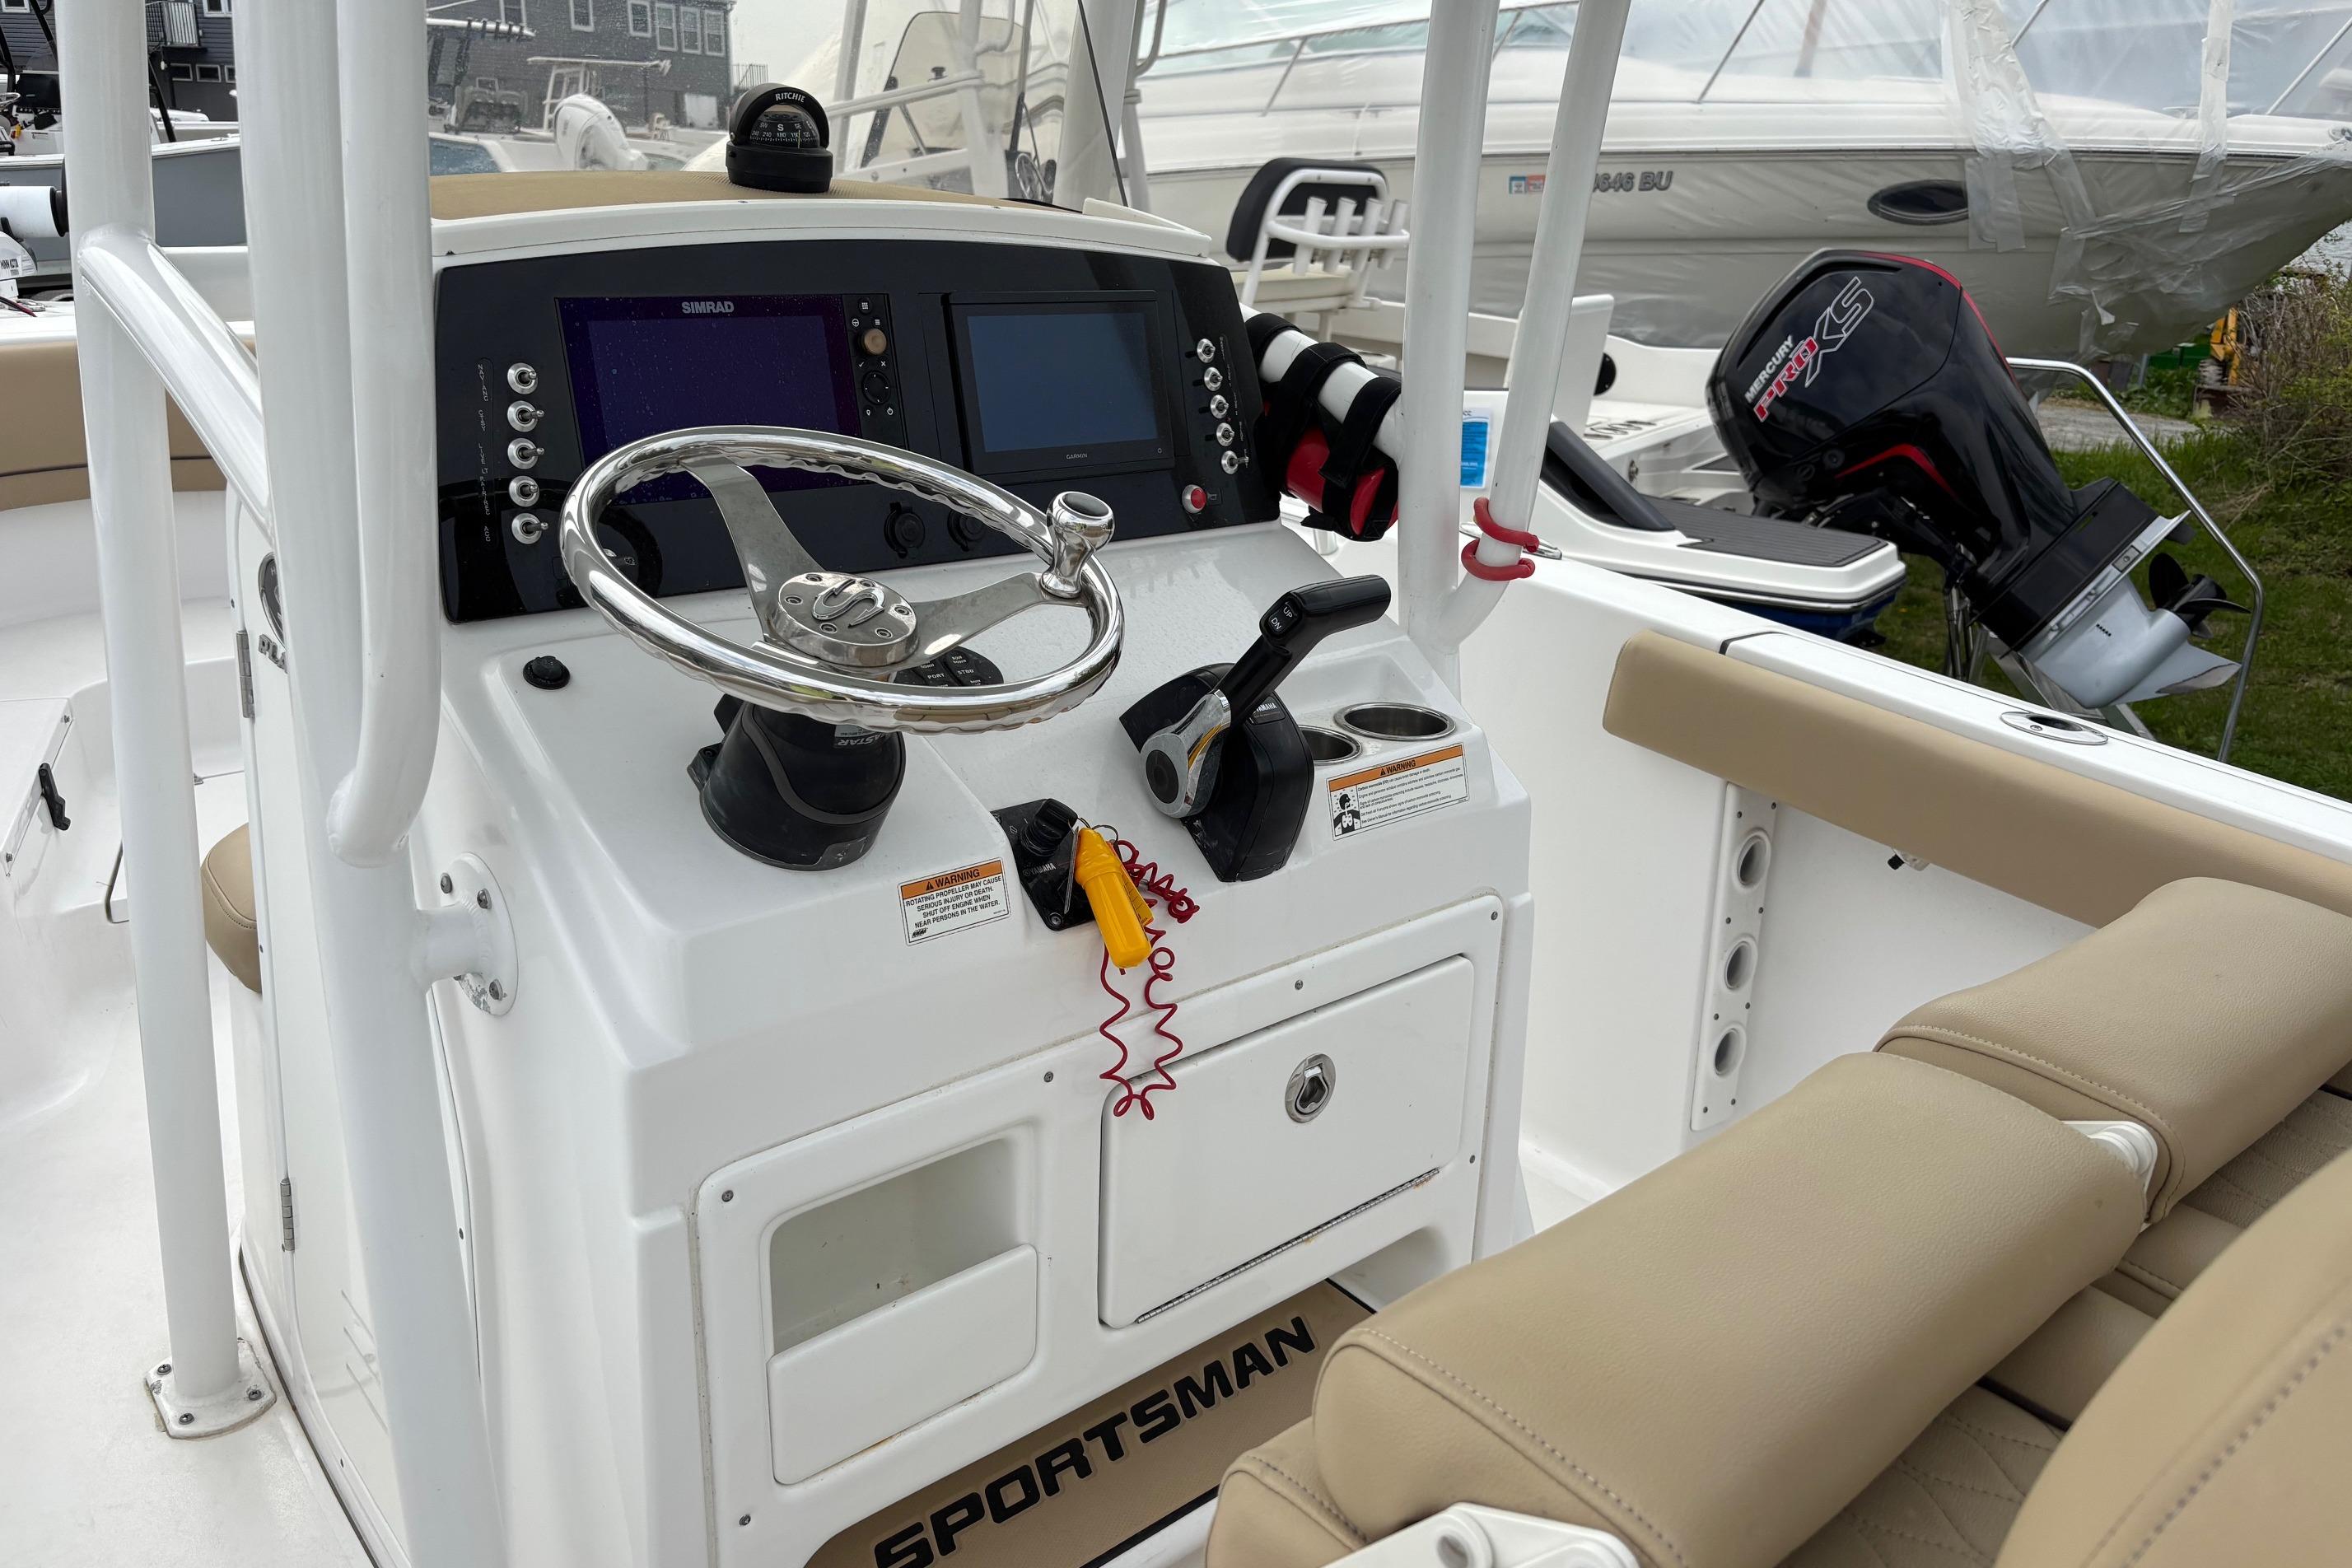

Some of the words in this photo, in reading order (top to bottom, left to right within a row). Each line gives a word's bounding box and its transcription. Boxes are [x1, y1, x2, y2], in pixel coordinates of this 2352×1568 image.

[776, 92, 805, 102] RITCHIE
[1639, 171, 1673, 191] BU
[682, 301, 734, 313] SIMRAD
[1744, 334, 1794, 404] MERCURY
[1753, 336, 1818, 422] PRO
[1283, 606, 1293, 618] UP
[1271, 618, 1282, 629] DN
[1386, 760, 1416, 774] WARNING
[936, 869, 980, 888] WARNING
[1030, 863, 1056, 875] YAMAHA
[906, 894, 934, 907] ROTATING
[936, 884, 969, 898] PROPELLER
[971, 880, 982, 889] MAY
[983, 876, 1001, 885] CAUSE
[917, 900, 942, 912] SERIOUS
[944, 894, 963, 904] INJURY
[974, 886, 993, 896] DEATH.
[915, 918, 931, 928] NEAR
[932, 911, 959, 923] PERSONS
[968, 905, 978, 913] THE
[979, 900, 1000, 910] WATER.
[923, 909, 938, 918] SHUT
[940, 905, 950, 913] OFF
[953, 900, 973, 911] ENGINE
[974, 894, 990, 904] WHEN
[874, 1315, 1316, 1568] SPORTSMAN
